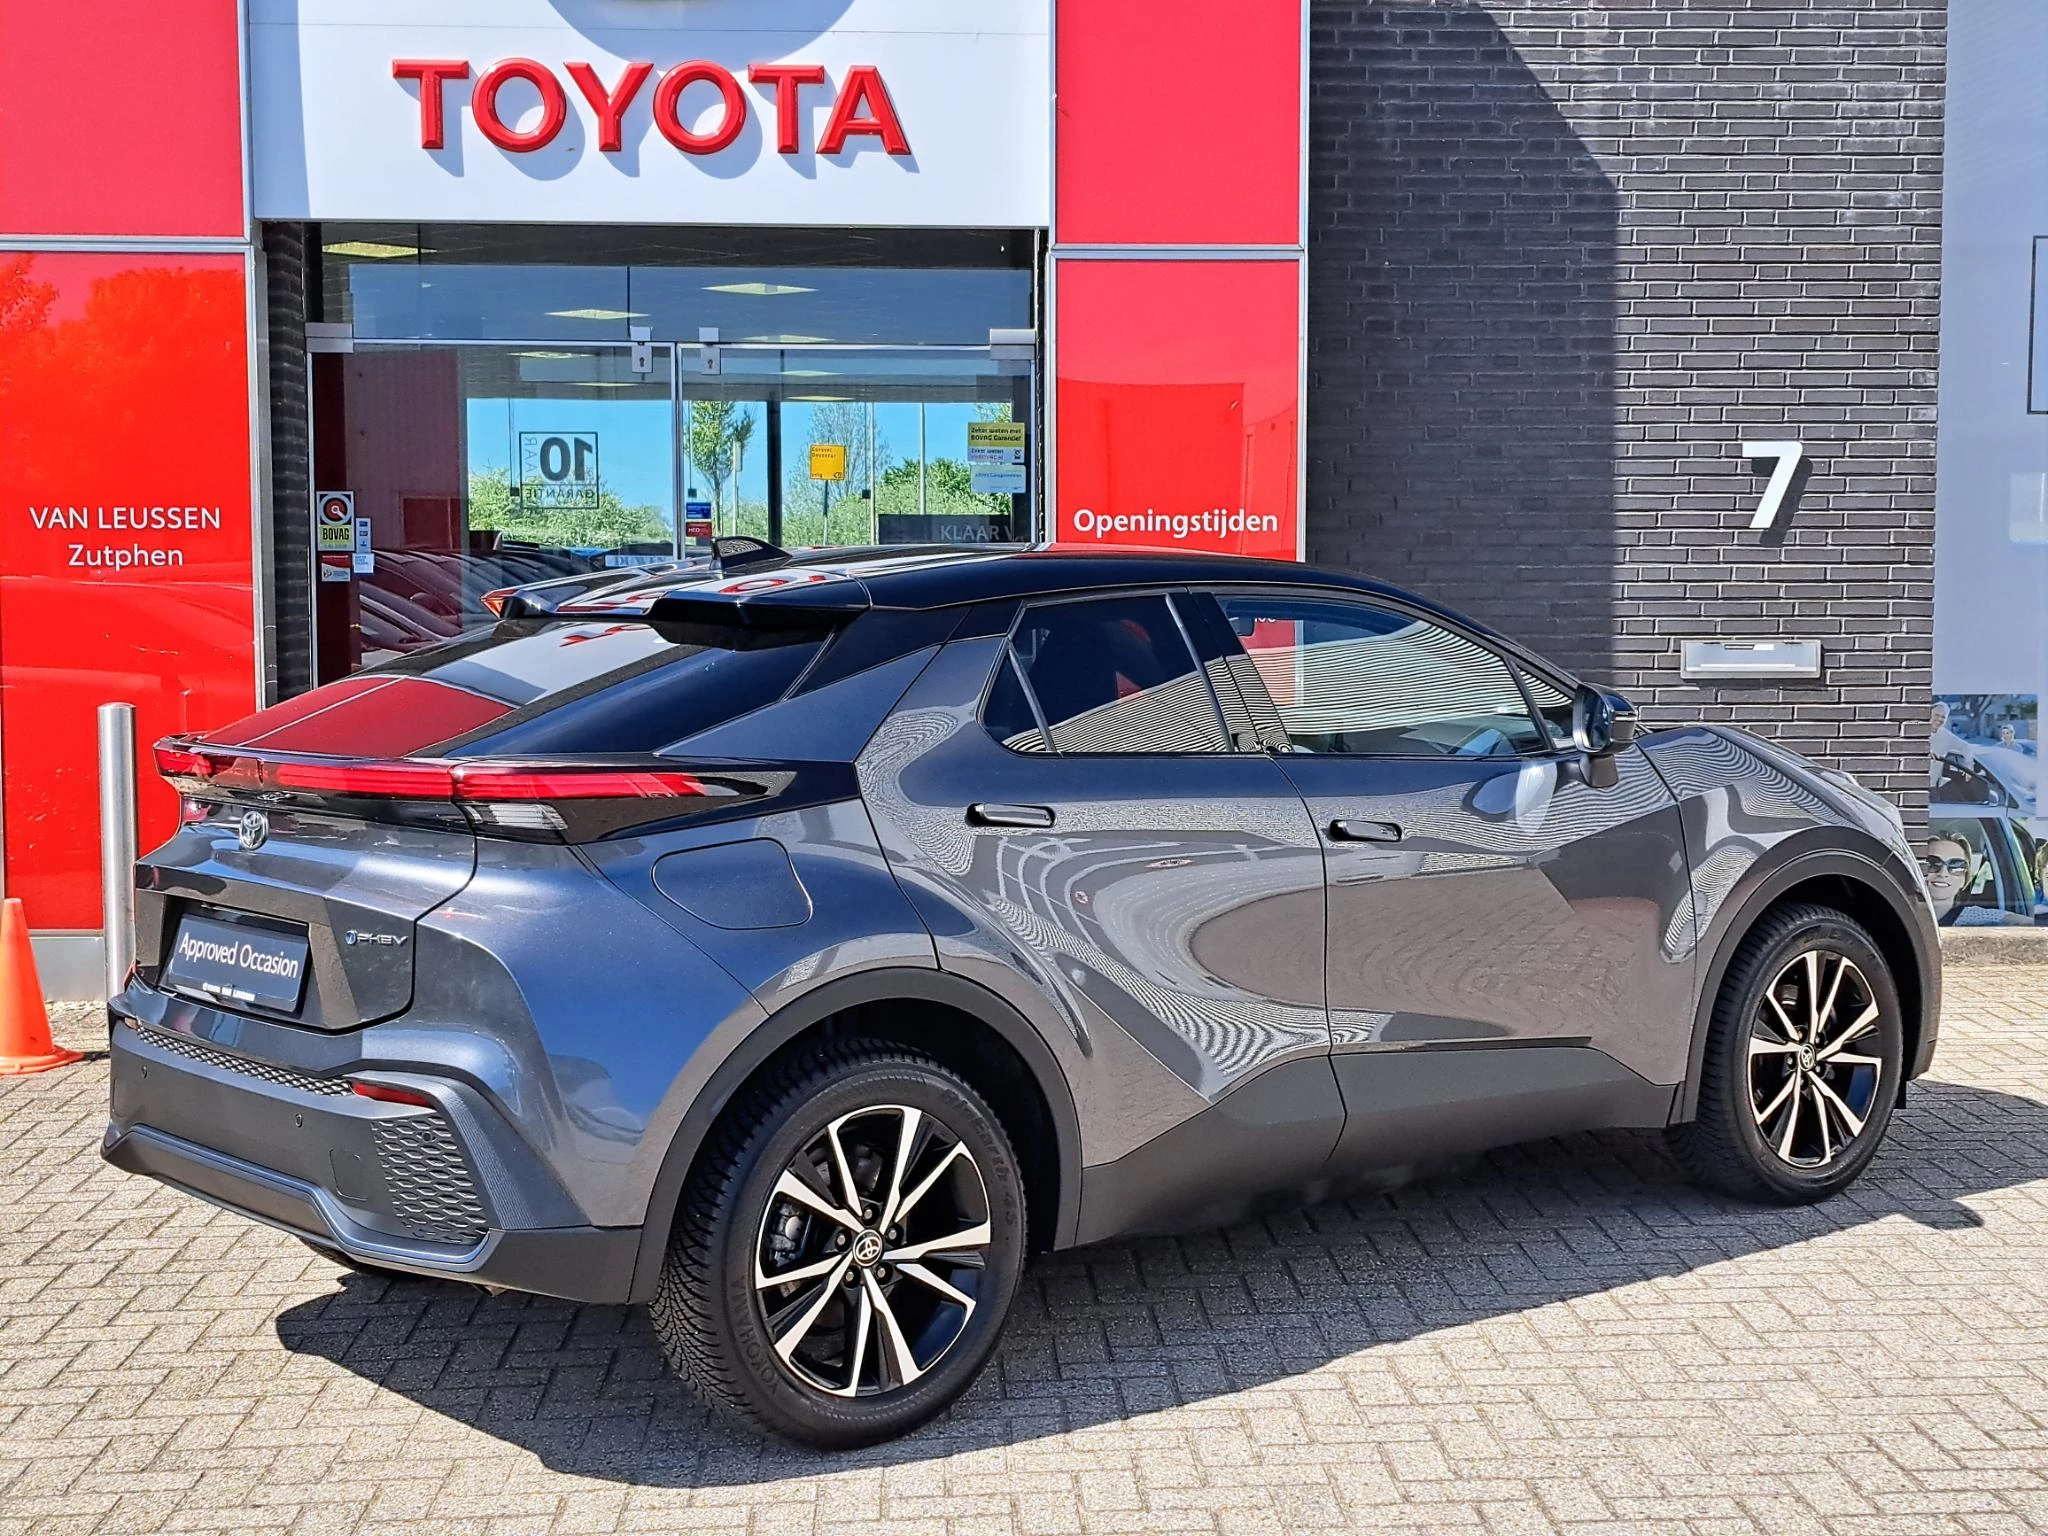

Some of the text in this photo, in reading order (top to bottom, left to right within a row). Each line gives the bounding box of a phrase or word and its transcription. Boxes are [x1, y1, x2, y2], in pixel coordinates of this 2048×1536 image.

[392, 57, 912, 156] TOYOTA
[1741, 441, 1803, 528] 7
[29, 506, 221, 529] VAN LEUSSEN
[1073, 508, 1278, 539] Openingstijden
[322, 527, 350, 541] BOVAG
[940, 525, 1000, 541] KLAAR
[68, 543, 183, 571] Zutphen
[357, 932, 409, 946] PHEV
[178, 931, 299, 979] Approved Occasion
[730, 1273, 780, 1395] YOKOHAMA
